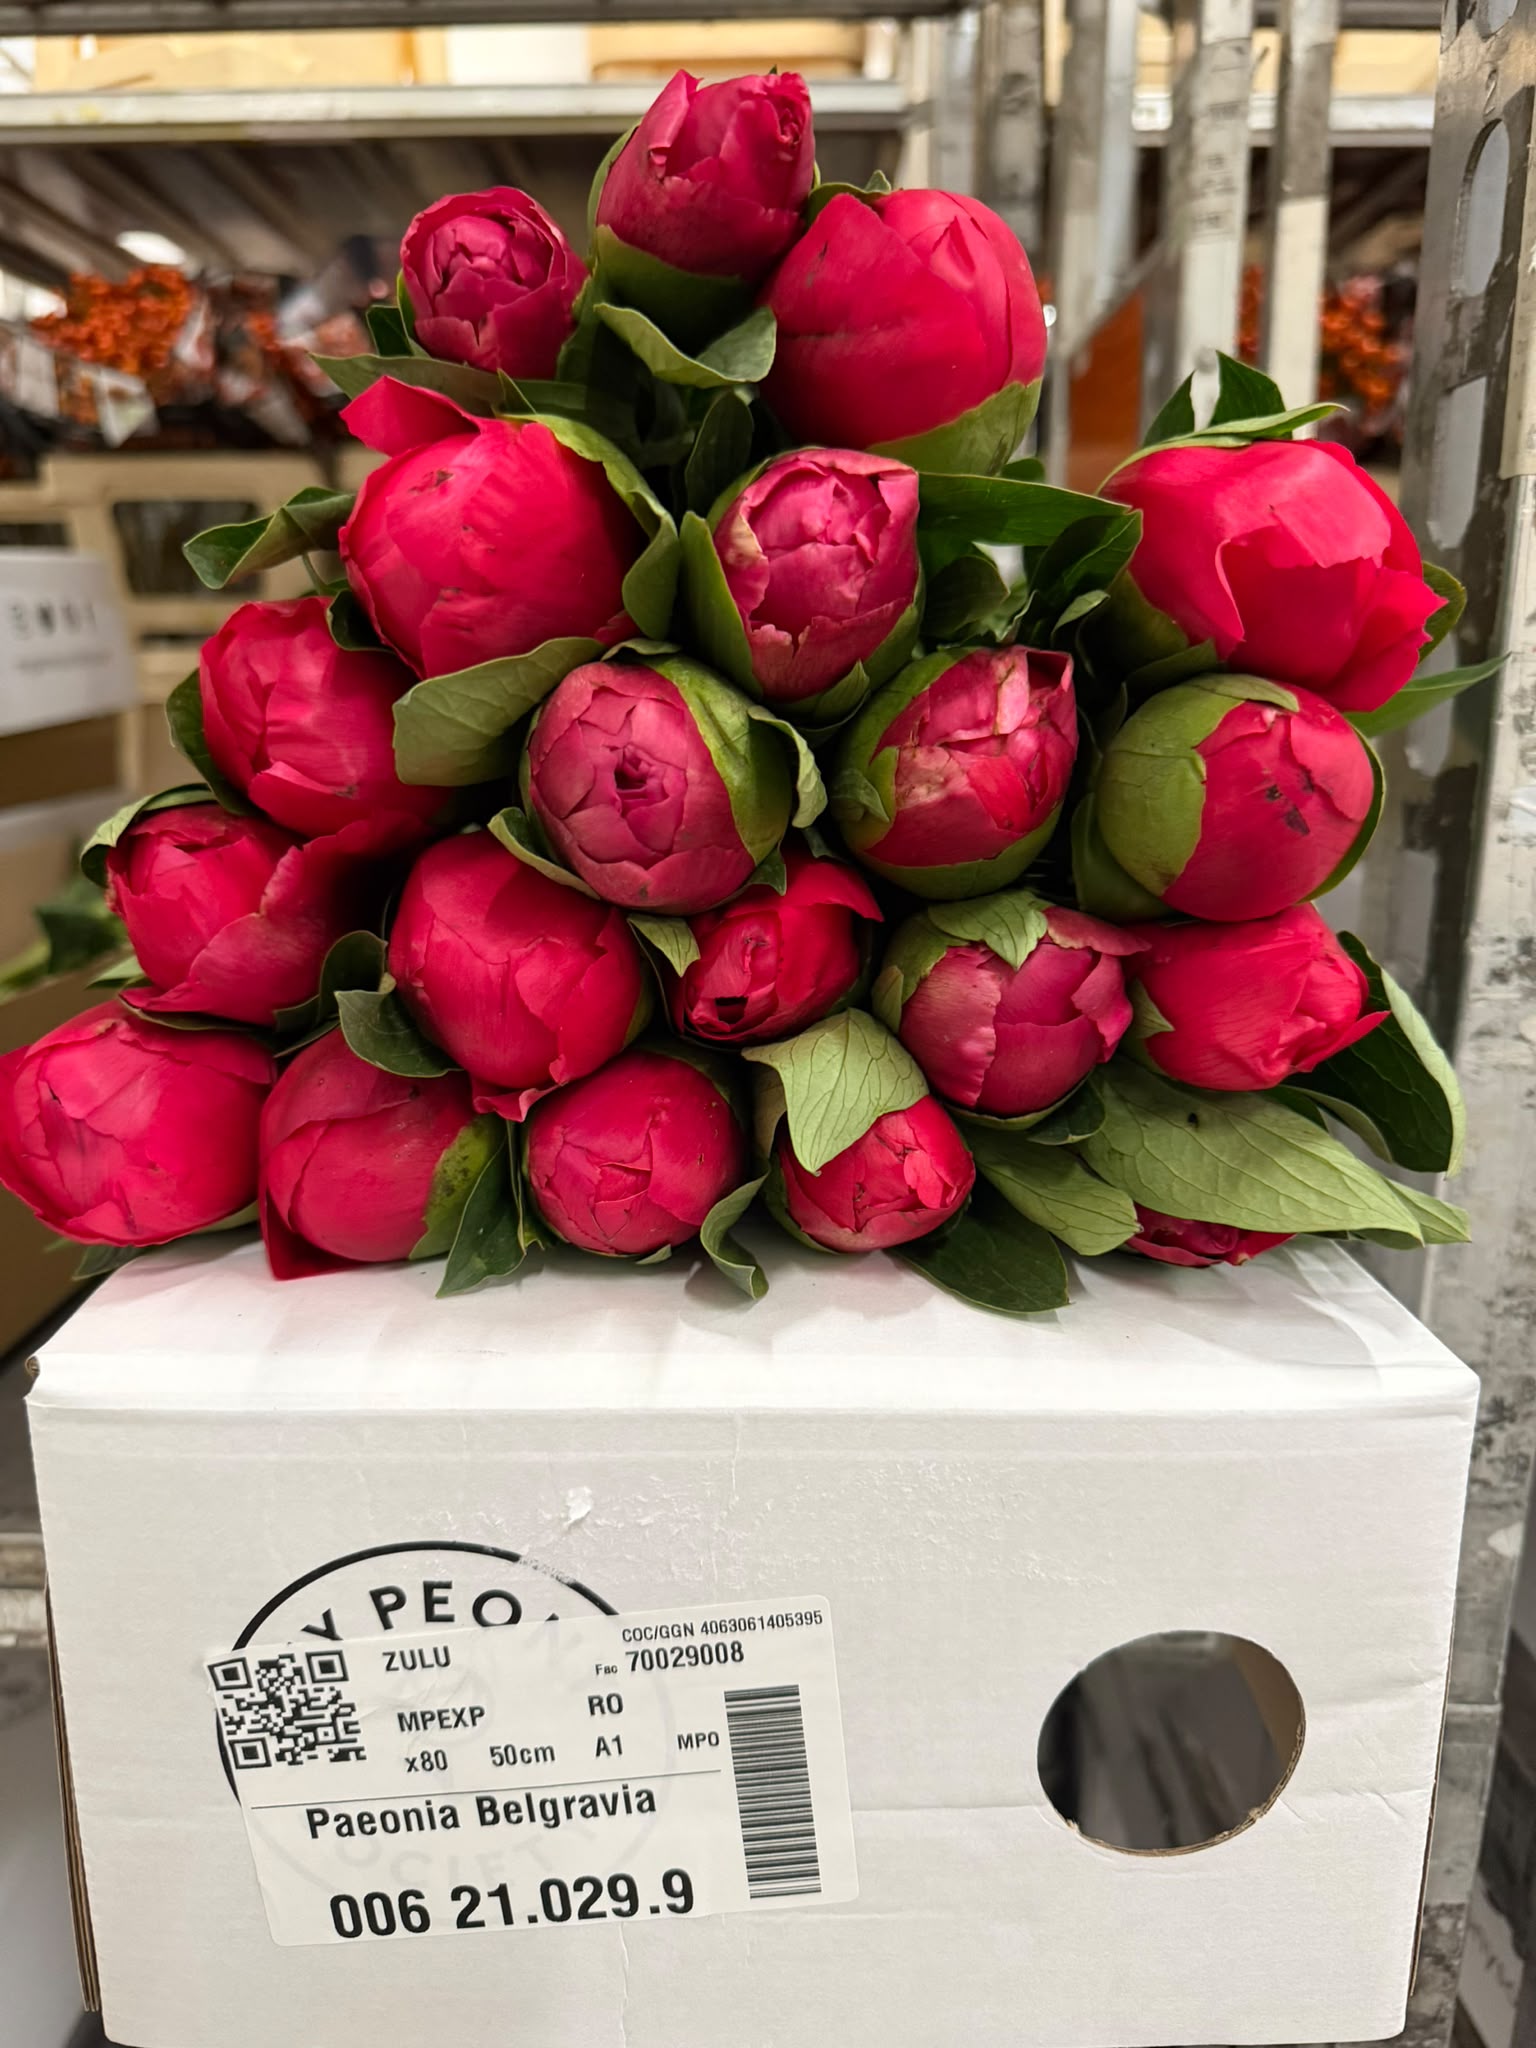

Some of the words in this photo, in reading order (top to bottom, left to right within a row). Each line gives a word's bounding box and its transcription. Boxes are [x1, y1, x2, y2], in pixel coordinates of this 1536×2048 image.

[299, 1607, 344, 1642] Y
[368, 1579, 560, 1631] PEO
[621, 1622, 695, 1643] COC/GGN
[700, 1609, 824, 1636] 4063061405395
[382, 1645, 452, 1673] ZULU
[624, 1640, 745, 1673] 70029008
[396, 1704, 486, 1733] MPEXP
[404, 1748, 449, 1773] x80
[488, 1743, 556, 1768] 50cm
[595, 1734, 623, 1758] A1
[305, 1798, 461, 1840] Paeonia
[475, 1783, 657, 1829] Belgravia
[329, 1888, 432, 1939] 006
[450, 1867, 695, 1930] 21.029.9
